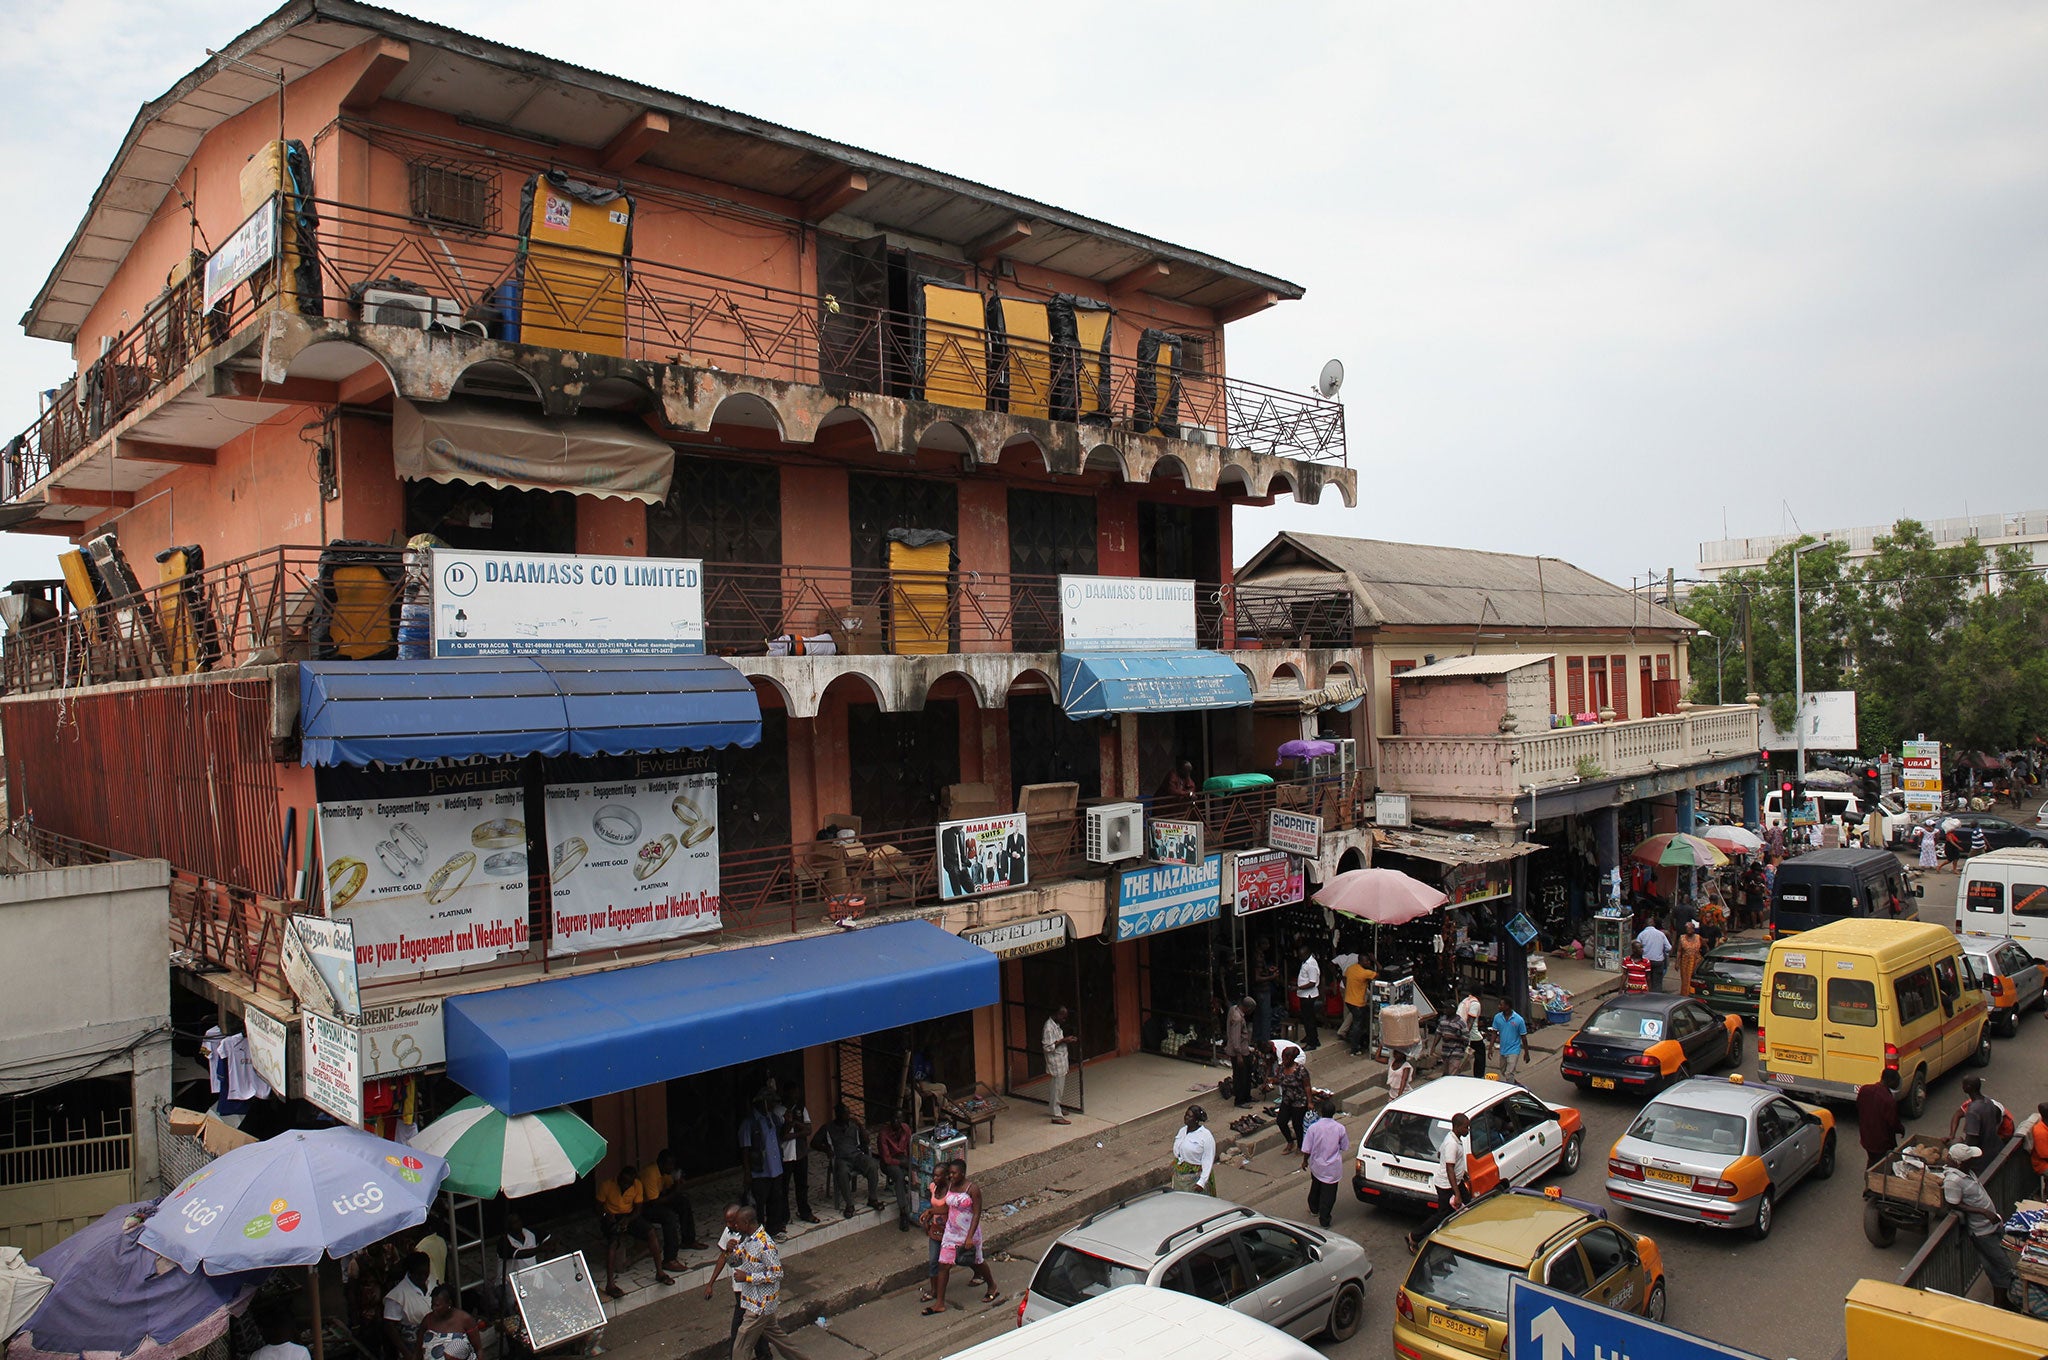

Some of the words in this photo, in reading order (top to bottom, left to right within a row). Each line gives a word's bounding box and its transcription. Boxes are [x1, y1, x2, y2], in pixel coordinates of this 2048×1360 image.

[451, 568, 464, 582] D
[485, 560, 585, 585] DAAMASS
[591, 563, 617, 586] CO
[623, 565, 698, 588] LIMITED
[1085, 584, 1136, 600] DAAMASS
[1139, 585, 1153, 601] CO
[1156, 586, 1194, 601] LIMITED
[635, 756, 710, 776] JEWELLERY
[429, 768, 521, 792] JEWELLERY
[593, 786, 623, 799] Engagement
[322, 805, 346, 818] Promise
[346, 804, 364, 818] Rings
[377, 802, 414, 816] Engagement
[414, 801, 430, 814] Rings
[444, 798, 467, 811] Wedding
[467, 796, 483, 810] Rings
[966, 823, 989, 834] MAMA
[991, 819, 1014, 830] MAY'S
[1273, 813, 1316, 834] SHOPRITE
[981, 829, 1001, 840] SUITS
[591, 860, 611, 868] WHITE
[505, 882, 523, 890] GOLD
[640, 881, 669, 891] PLATINUM
[1124, 873, 1150, 899] THE
[1152, 859, 1219, 893] NAZARENE
[378, 884, 401, 894] WHITE
[402, 883, 422, 892] GOLD
[1157, 880, 1216, 899] JEWELLERY
[438, 908, 472, 918] PLATINUM
[556, 911, 588, 939] Engrave
[589, 911, 606, 935] your
[608, 901, 653, 931] Engagement
[655, 895, 669, 920] and
[670, 890, 700, 919] Wedding
[699, 889, 721, 916] Rings
[297, 919, 329, 950] Citizen
[376, 941, 397, 968] your
[400, 930, 454, 965] Engagement
[456, 922, 474, 951] and
[474, 919, 514, 950] Wedding
[332, 1184, 384, 1215] tigo
[1545, 1188, 1559, 1197] TAXI
[1433, 1315, 1443, 1325] GW
[1445, 1319, 1477, 1337] 5818-13
